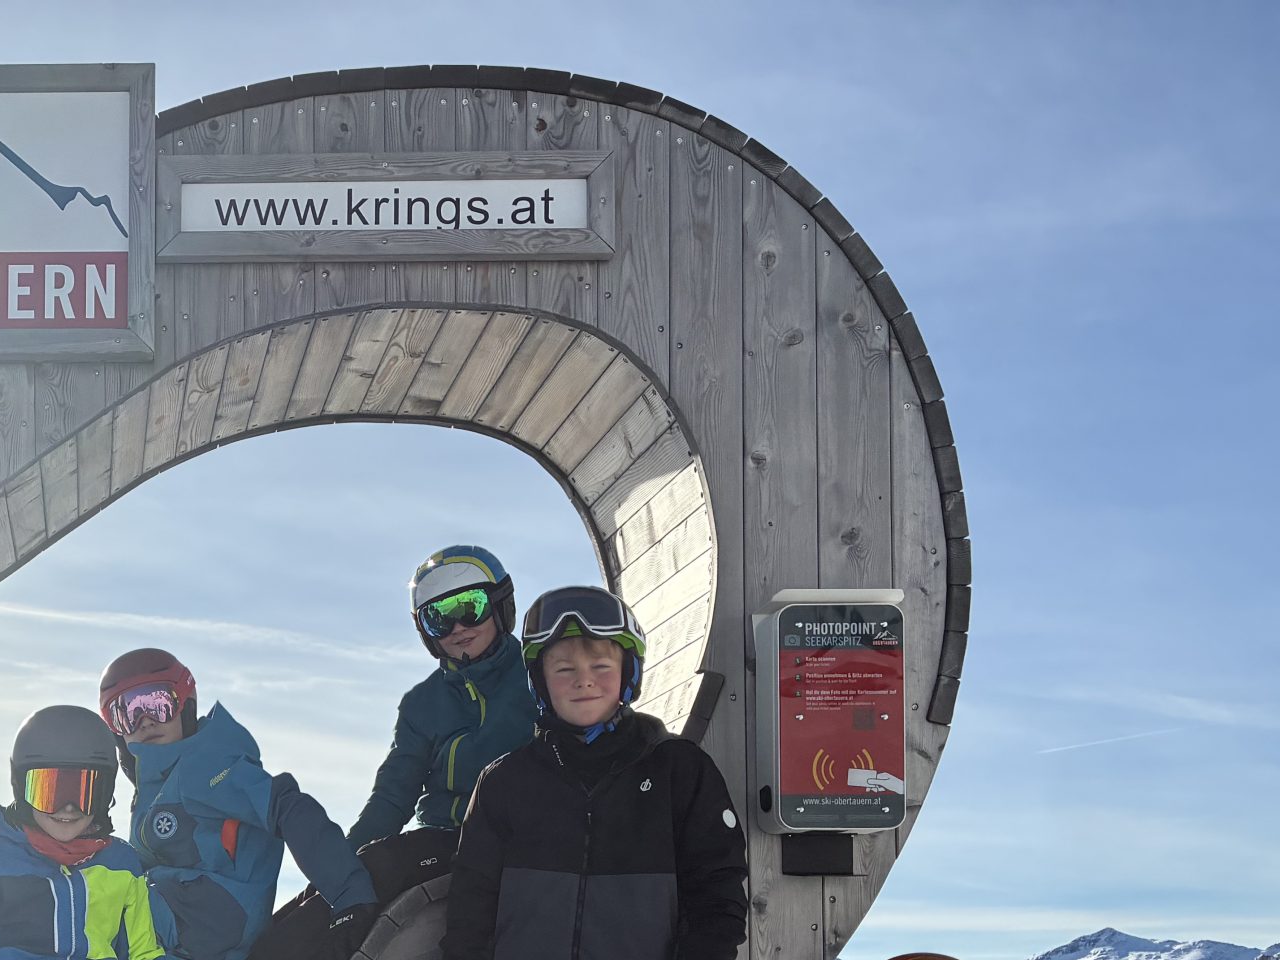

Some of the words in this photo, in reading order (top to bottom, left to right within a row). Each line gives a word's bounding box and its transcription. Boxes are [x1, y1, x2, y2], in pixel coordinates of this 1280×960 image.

[215, 188, 555, 230] www.krings.at
[805, 622, 877, 635] PHOTOPOINT
[805, 636, 862, 646] SEEKARSPITZ
[803, 797, 881, 806] www.ski-obertauern.at
[329, 913, 354, 929] LEKI
